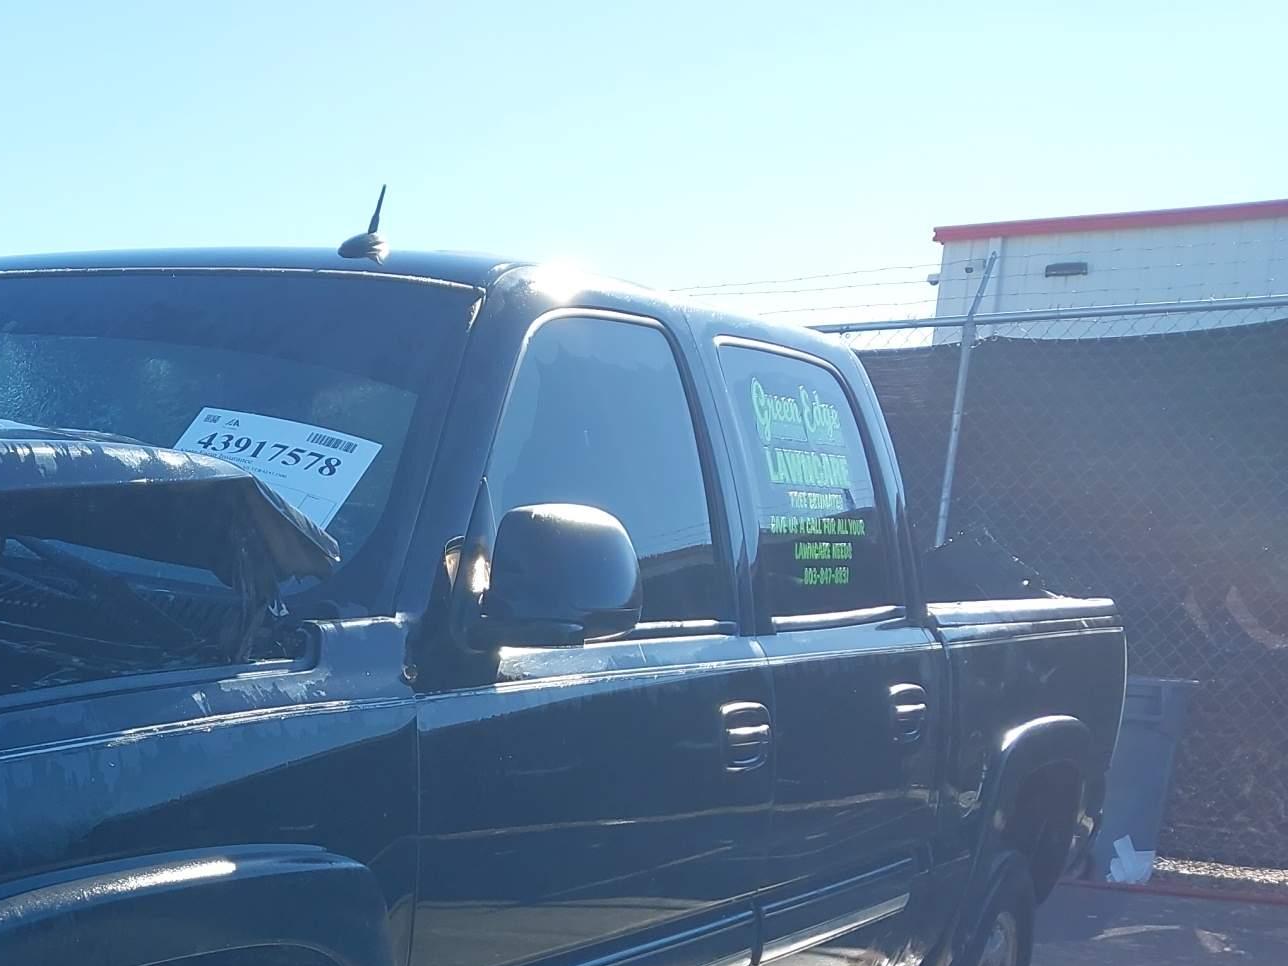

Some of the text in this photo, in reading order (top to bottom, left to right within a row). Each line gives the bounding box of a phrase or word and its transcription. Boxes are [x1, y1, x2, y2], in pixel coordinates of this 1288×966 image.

[196, 432, 343, 477] 43917578
[770, 515, 865, 536] GIVE US A CALL FOR ALL YOUR
[794, 542, 853, 560] LAWNCARE NEEDS
